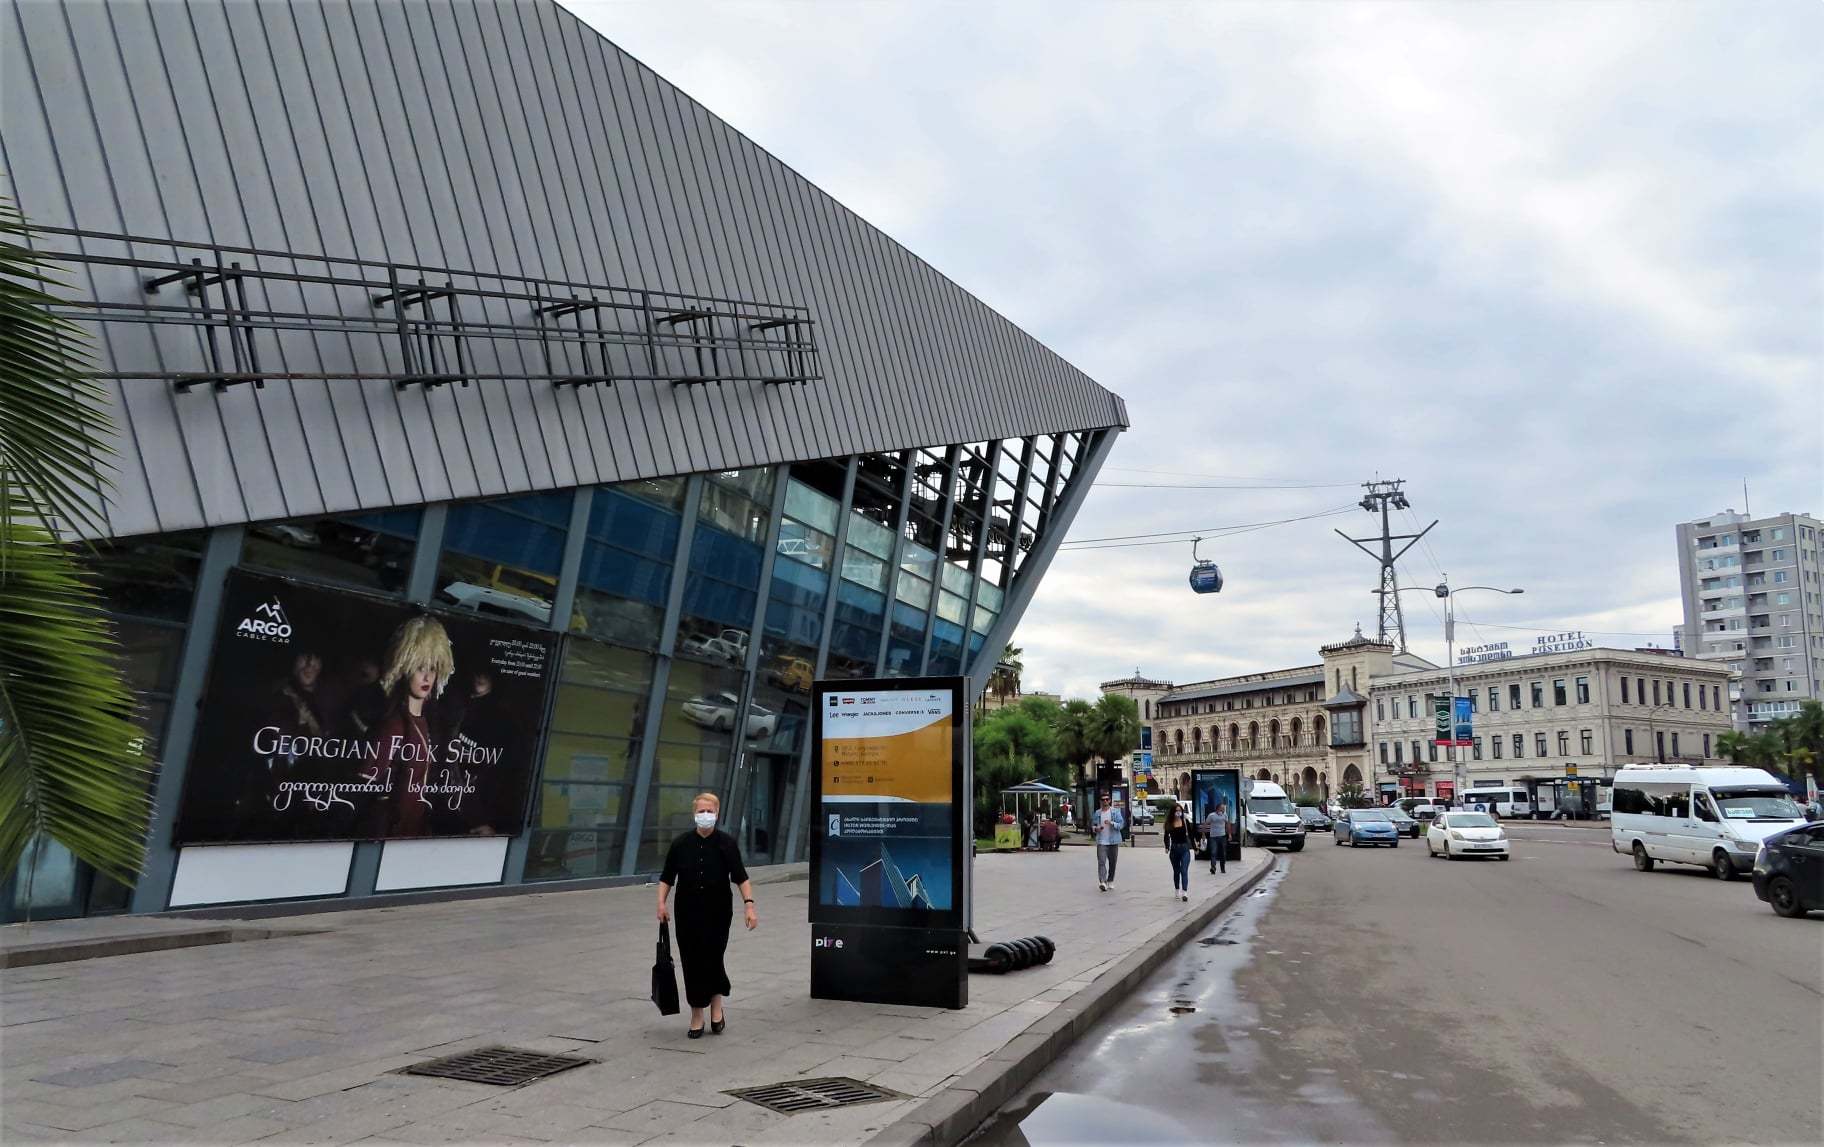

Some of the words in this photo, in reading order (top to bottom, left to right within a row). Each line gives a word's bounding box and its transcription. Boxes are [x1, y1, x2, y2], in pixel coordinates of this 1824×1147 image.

[238, 618, 292, 637] ARGO
[237, 631, 267, 641] CABLE
[272, 636, 290, 644] CAR
[1537, 631, 1585, 644] HOTEL
[1532, 639, 1592, 654] POSEIDON
[408, 768, 476, 811] საღამოები
